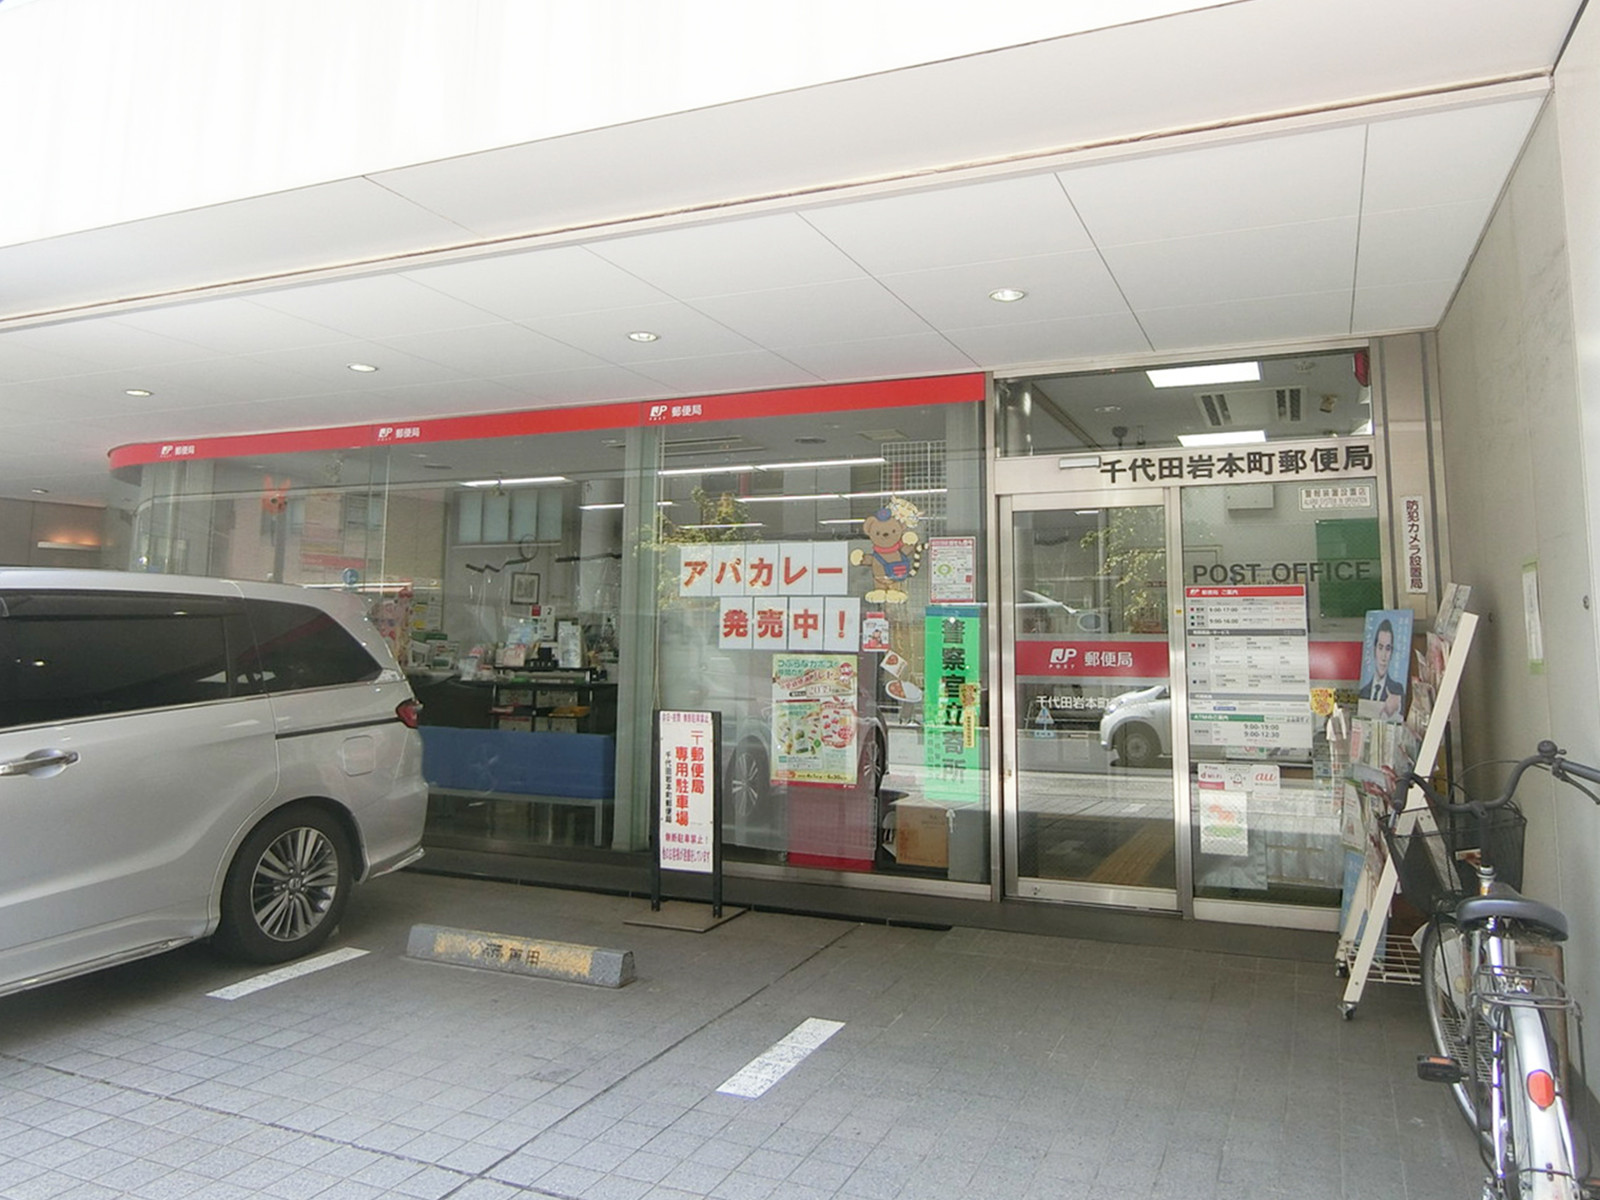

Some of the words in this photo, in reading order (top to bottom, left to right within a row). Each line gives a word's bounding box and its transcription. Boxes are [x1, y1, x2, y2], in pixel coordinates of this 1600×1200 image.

[671, 404, 702, 417] 郵便局
[1100, 445, 1373, 483] 千代田岩本町郵便局
[1406, 500, 1423, 589] 防犯カメラ設置局
[684, 556, 843, 587] アパカレー
[1193, 563, 1261, 584] POST
[1271, 561, 1370, 582] OFFICE
[723, 609, 845, 639] 発売中!
[1084, 651, 1133, 667] 郵便局
[942, 617, 966, 784] 警察官立寄所
[676, 747, 689, 827] 専用駐車場
[1255, 772, 1277, 781] au
